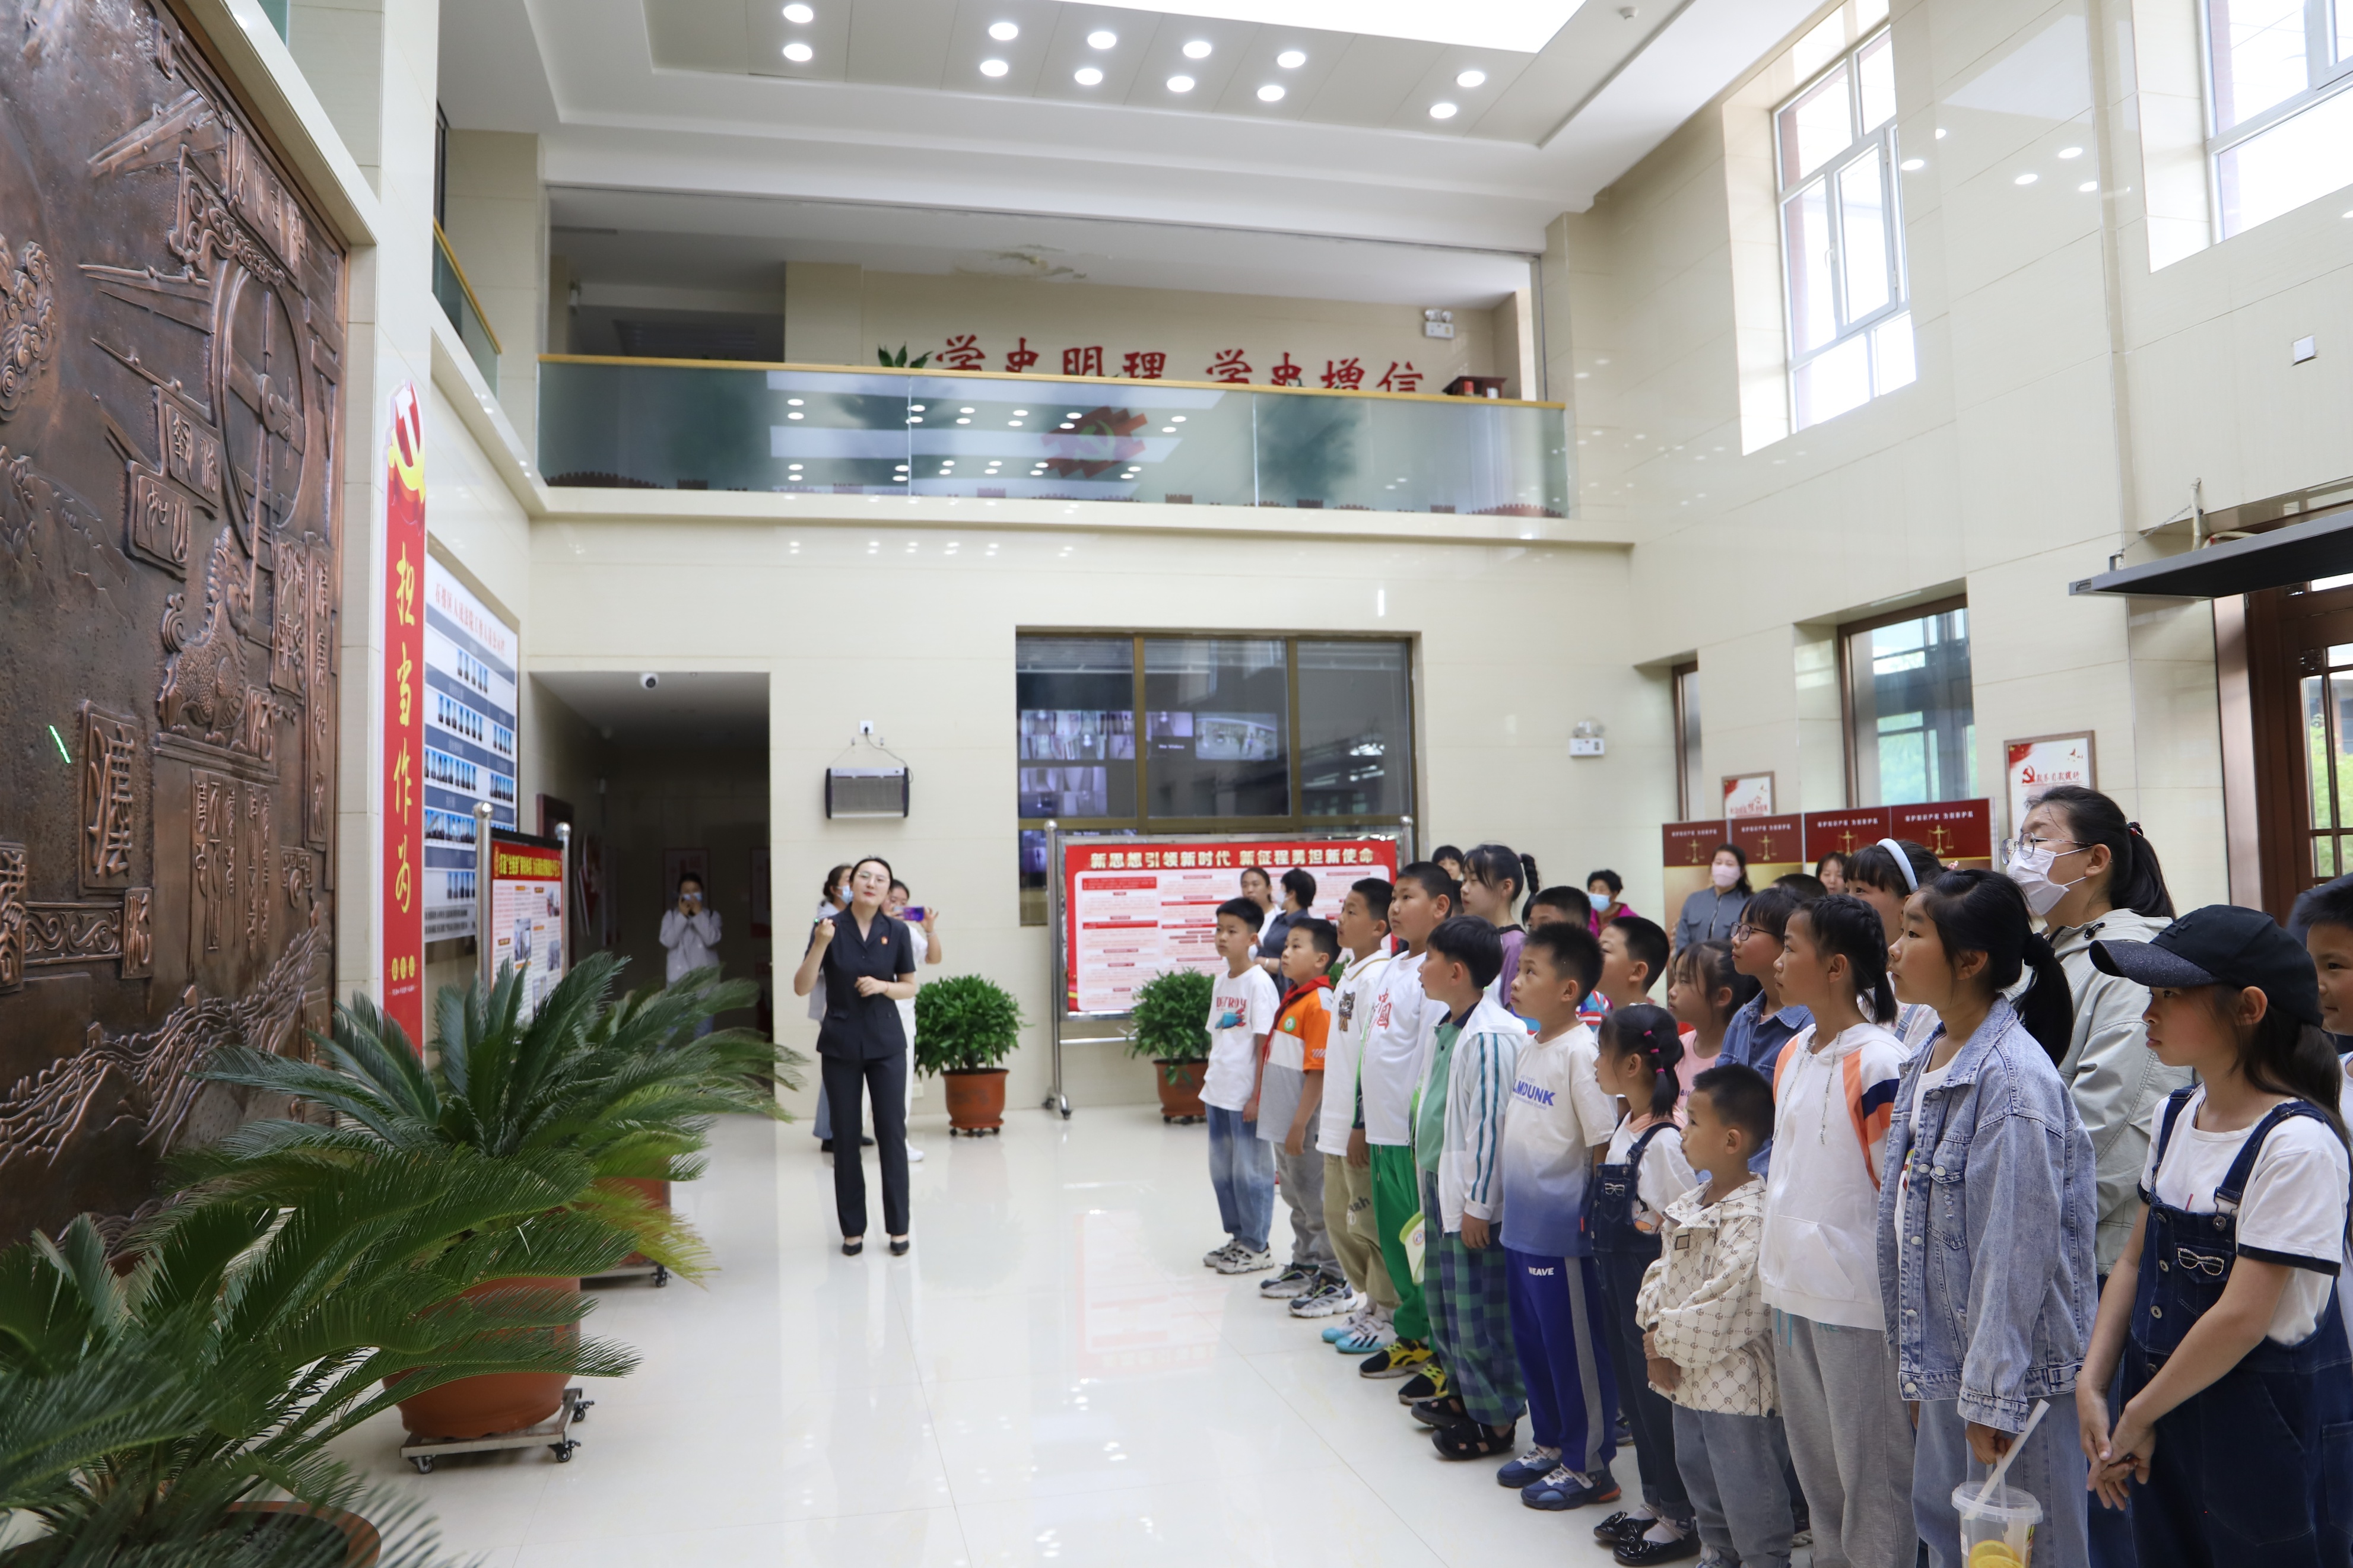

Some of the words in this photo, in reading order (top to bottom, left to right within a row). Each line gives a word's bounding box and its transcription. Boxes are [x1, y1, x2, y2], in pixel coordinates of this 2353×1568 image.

[936, 335, 1167, 380] 学史明理
[1206, 348, 1424, 393] 学史增信
[393, 542, 416, 914] 担当作为
[1905, 813, 1939, 822] 保护知识产权
[1090, 850, 1232, 869] 新思想引领新时代
[1239, 848, 1374, 866] 新征程勇担新使命
[1528, 1266, 1554, 1276] WEAVE
